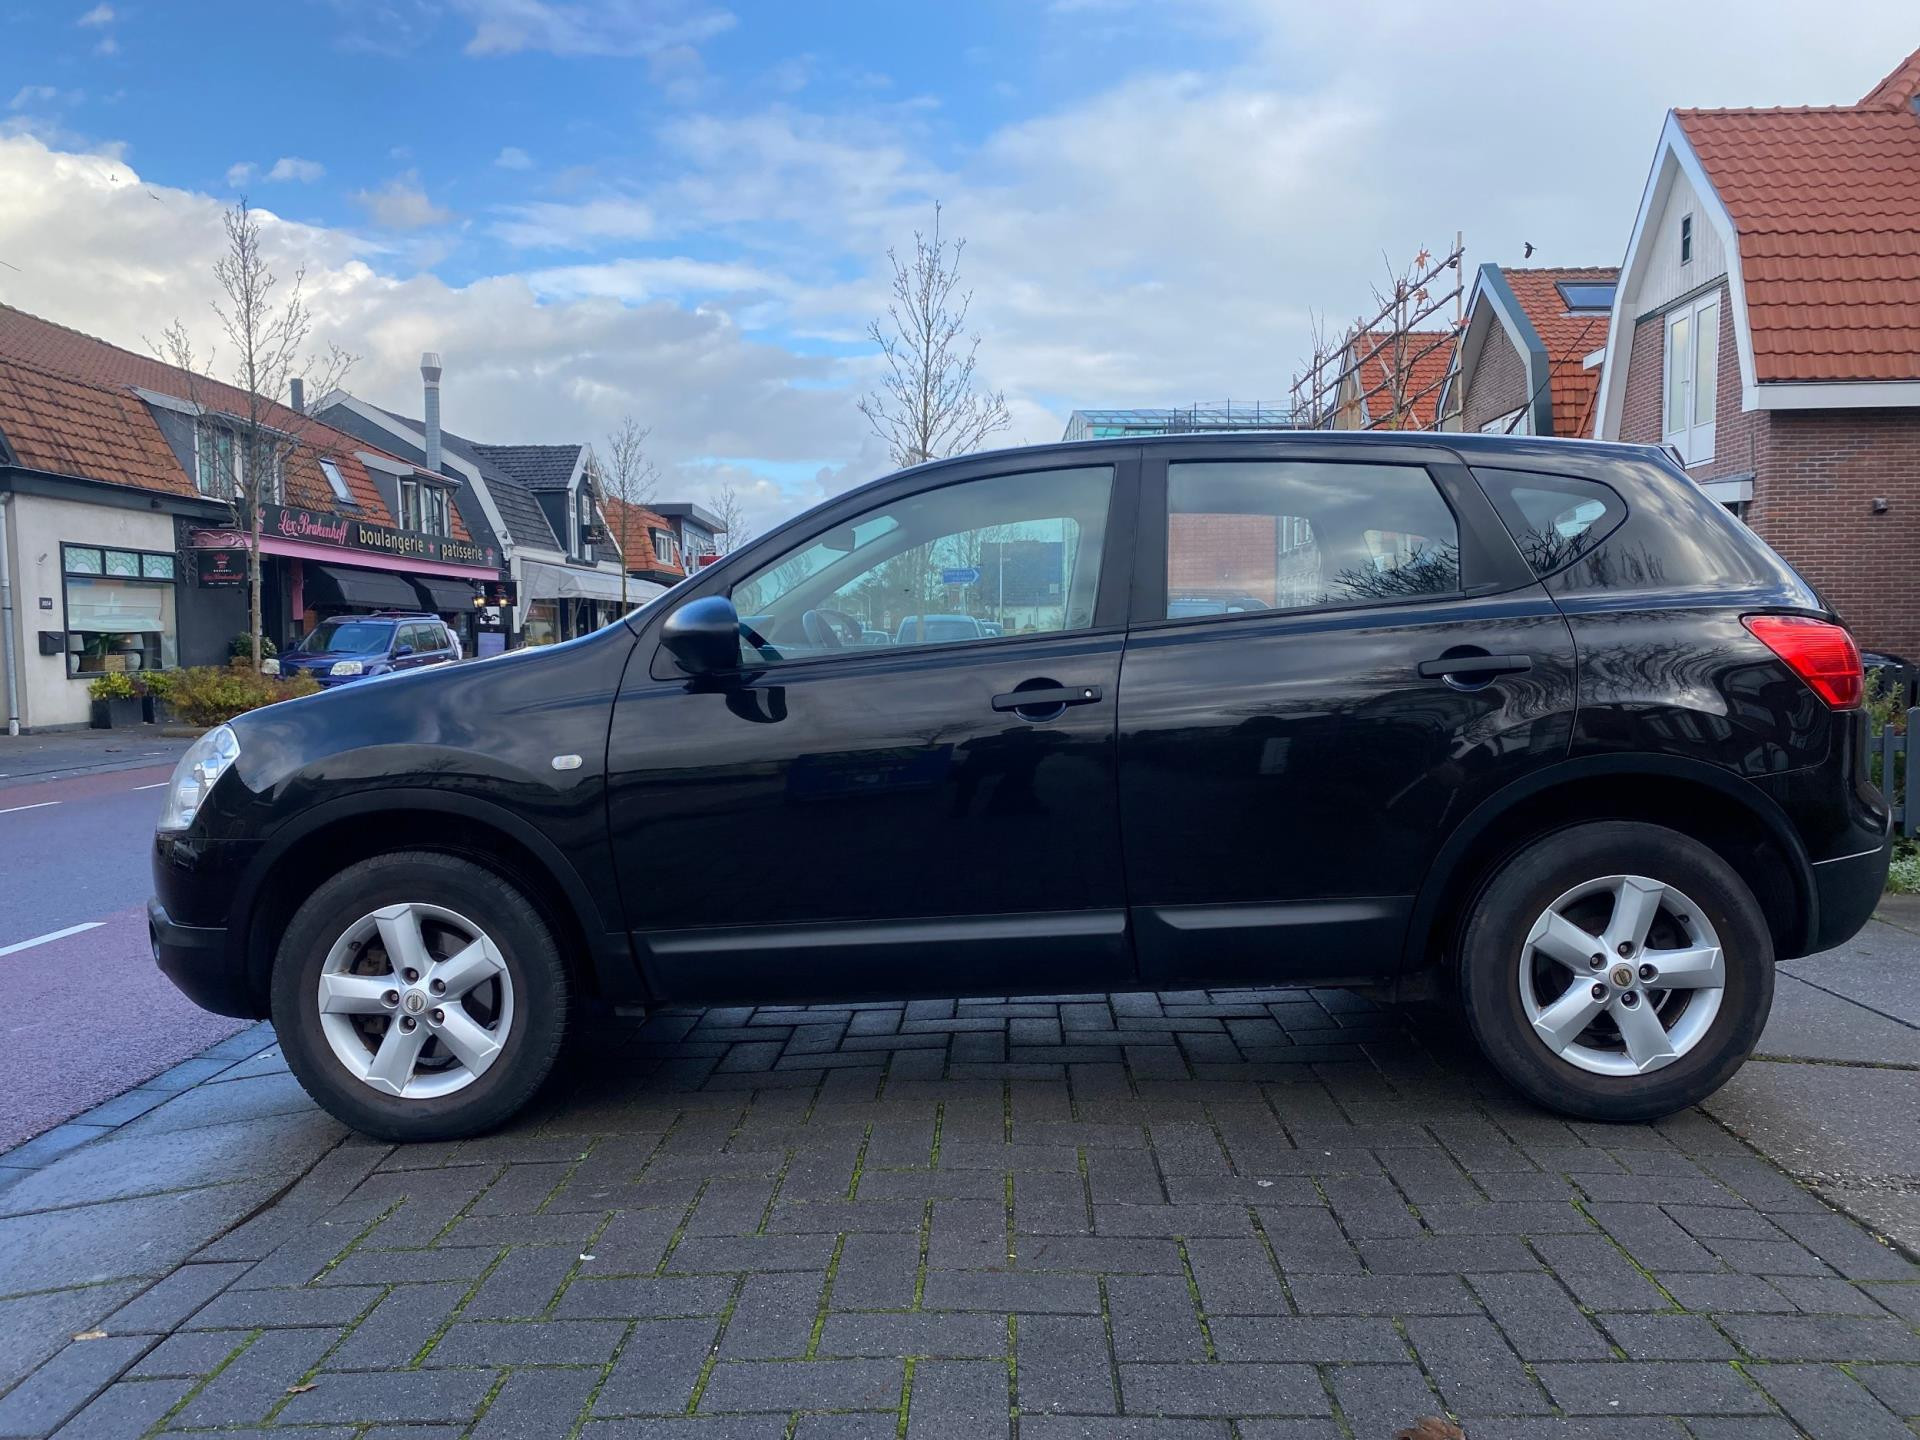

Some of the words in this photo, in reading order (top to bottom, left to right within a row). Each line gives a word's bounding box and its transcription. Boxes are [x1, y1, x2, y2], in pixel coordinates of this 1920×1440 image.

[278, 509, 299, 537] Lex
[298, 512, 349, 545] Brakenhoff
[359, 524, 424, 555] boulangerie
[441, 541, 483, 561] patisserie
